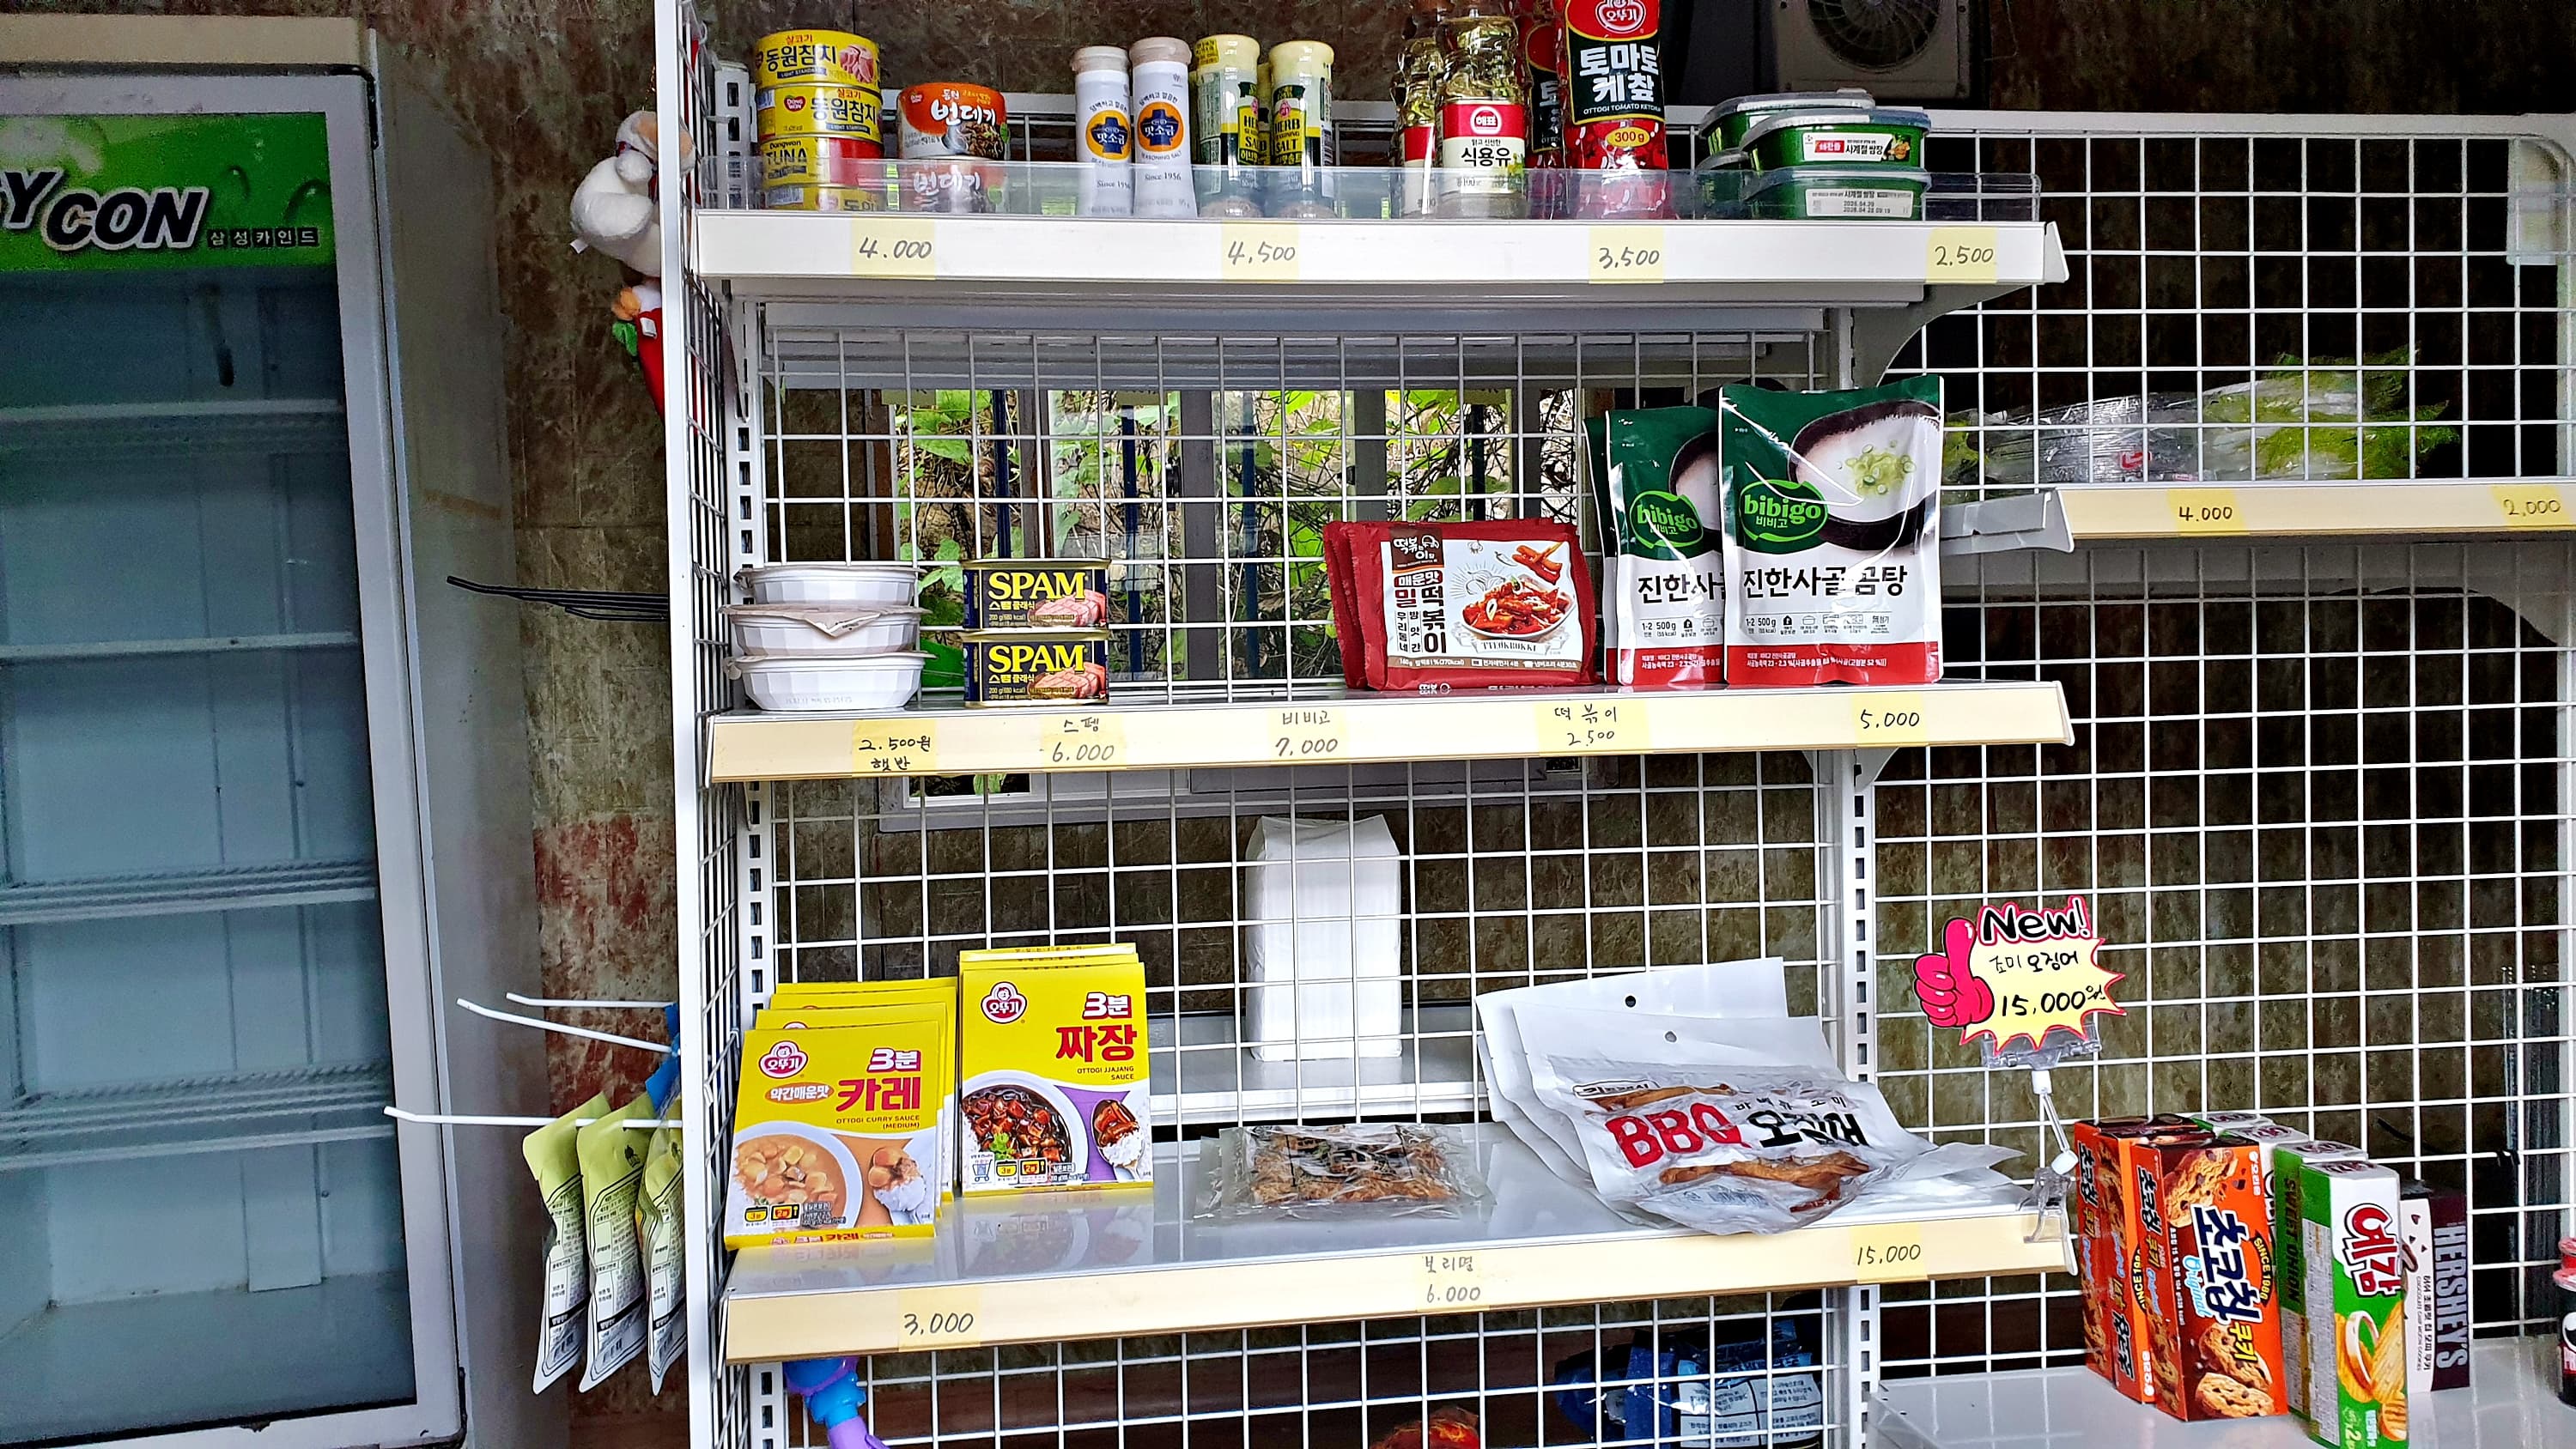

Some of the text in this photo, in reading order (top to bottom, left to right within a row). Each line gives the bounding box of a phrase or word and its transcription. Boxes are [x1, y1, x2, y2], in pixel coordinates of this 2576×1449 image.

[1606, 9, 1638, 21] 오뚜기
[786, 33, 813, 45] 살코기
[766, 45, 836, 72] 동원참치
[1580, 44, 1659, 76] 토마토
[837, 88, 861, 99] 살코기
[943, 89, 959, 100] 동원
[1593, 73, 1655, 102] 케찹
[811, 98, 876, 124] 동원참치
[931, 99, 996, 126] 번데기
[1611, 103, 1640, 112] TOMATO
[1145, 124, 1175, 137] 맛소금
[1274, 118, 1300, 133] HERB
[1475, 116, 1498, 126] 해표
[769, 140, 801, 149] Dongwon
[1097, 133, 1126, 146] 맛소금
[1275, 138, 1299, 154] SALT
[1845, 145, 1884, 155] 사계절 쌈장
[765, 148, 807, 166] TUNA
[1461, 147, 1511, 167] 식용유
[913, 171, 981, 197] 번데기
[1097, 179, 1115, 188] Since
[1145, 172, 1182, 181] Since 1956
[210, 227, 319, 247] 삼성카인드
[859, 236, 933, 259] 4.000
[1636, 504, 1698, 532] bibigo
[1743, 495, 1822, 524] bibigo
[1755, 514, 1789, 528] 비비고
[987, 572, 1086, 600] SPAM
[1398, 571, 1439, 586] 매운맛
[988, 602, 1036, 611] 스팸 클래식
[1395, 585, 1447, 654] 밀 떡볶이
[1397, 611, 1408, 652] 우리동네
[987, 645, 1085, 673] SPAM
[988, 674, 1035, 684] 스팸 클래식
[1282, 711, 1331, 725] 비비고
[870, 755, 910, 772] 햇반
[1983, 899, 2091, 942] New!
[1989, 950, 2080, 973] 조미 오징어
[989, 999, 1019, 1015] 오뚜기
[1084, 992, 1131, 1018] 3분
[1055, 1024, 1138, 1063] 짜장
[767, 1057, 800, 1070] 오뚜기
[868, 1048, 920, 1072] 3분
[769, 1084, 831, 1100] 약간매운맛
[835, 1076, 921, 1113] 카레
[883, 1122, 920, 1131] (MEDIUM)
[1605, 1102, 1753, 1168] BBQ
[2077, 1141, 2098, 1207] 초코칩
[2250, 1164, 2261, 1196] 오리온
[2138, 1166, 2162, 1235] 초코칩
[2283, 1177, 2299, 1238] SWEET
[2084, 1207, 2096, 1238] 쿠키
[2147, 1235, 2160, 1265] 쿠키
[2253, 1236, 2271, 1271] SINCE
[2351, 1206, 2401, 1294] 예감
[2194, 1206, 2262, 1361] 초코칩 쿠키
[2285, 1242, 2302, 1304] ONION
[2183, 1256, 2210, 1316] Original
[2433, 1226, 2469, 1368] HERSHEY'S
[2112, 1312, 2135, 1381] 초코칩
